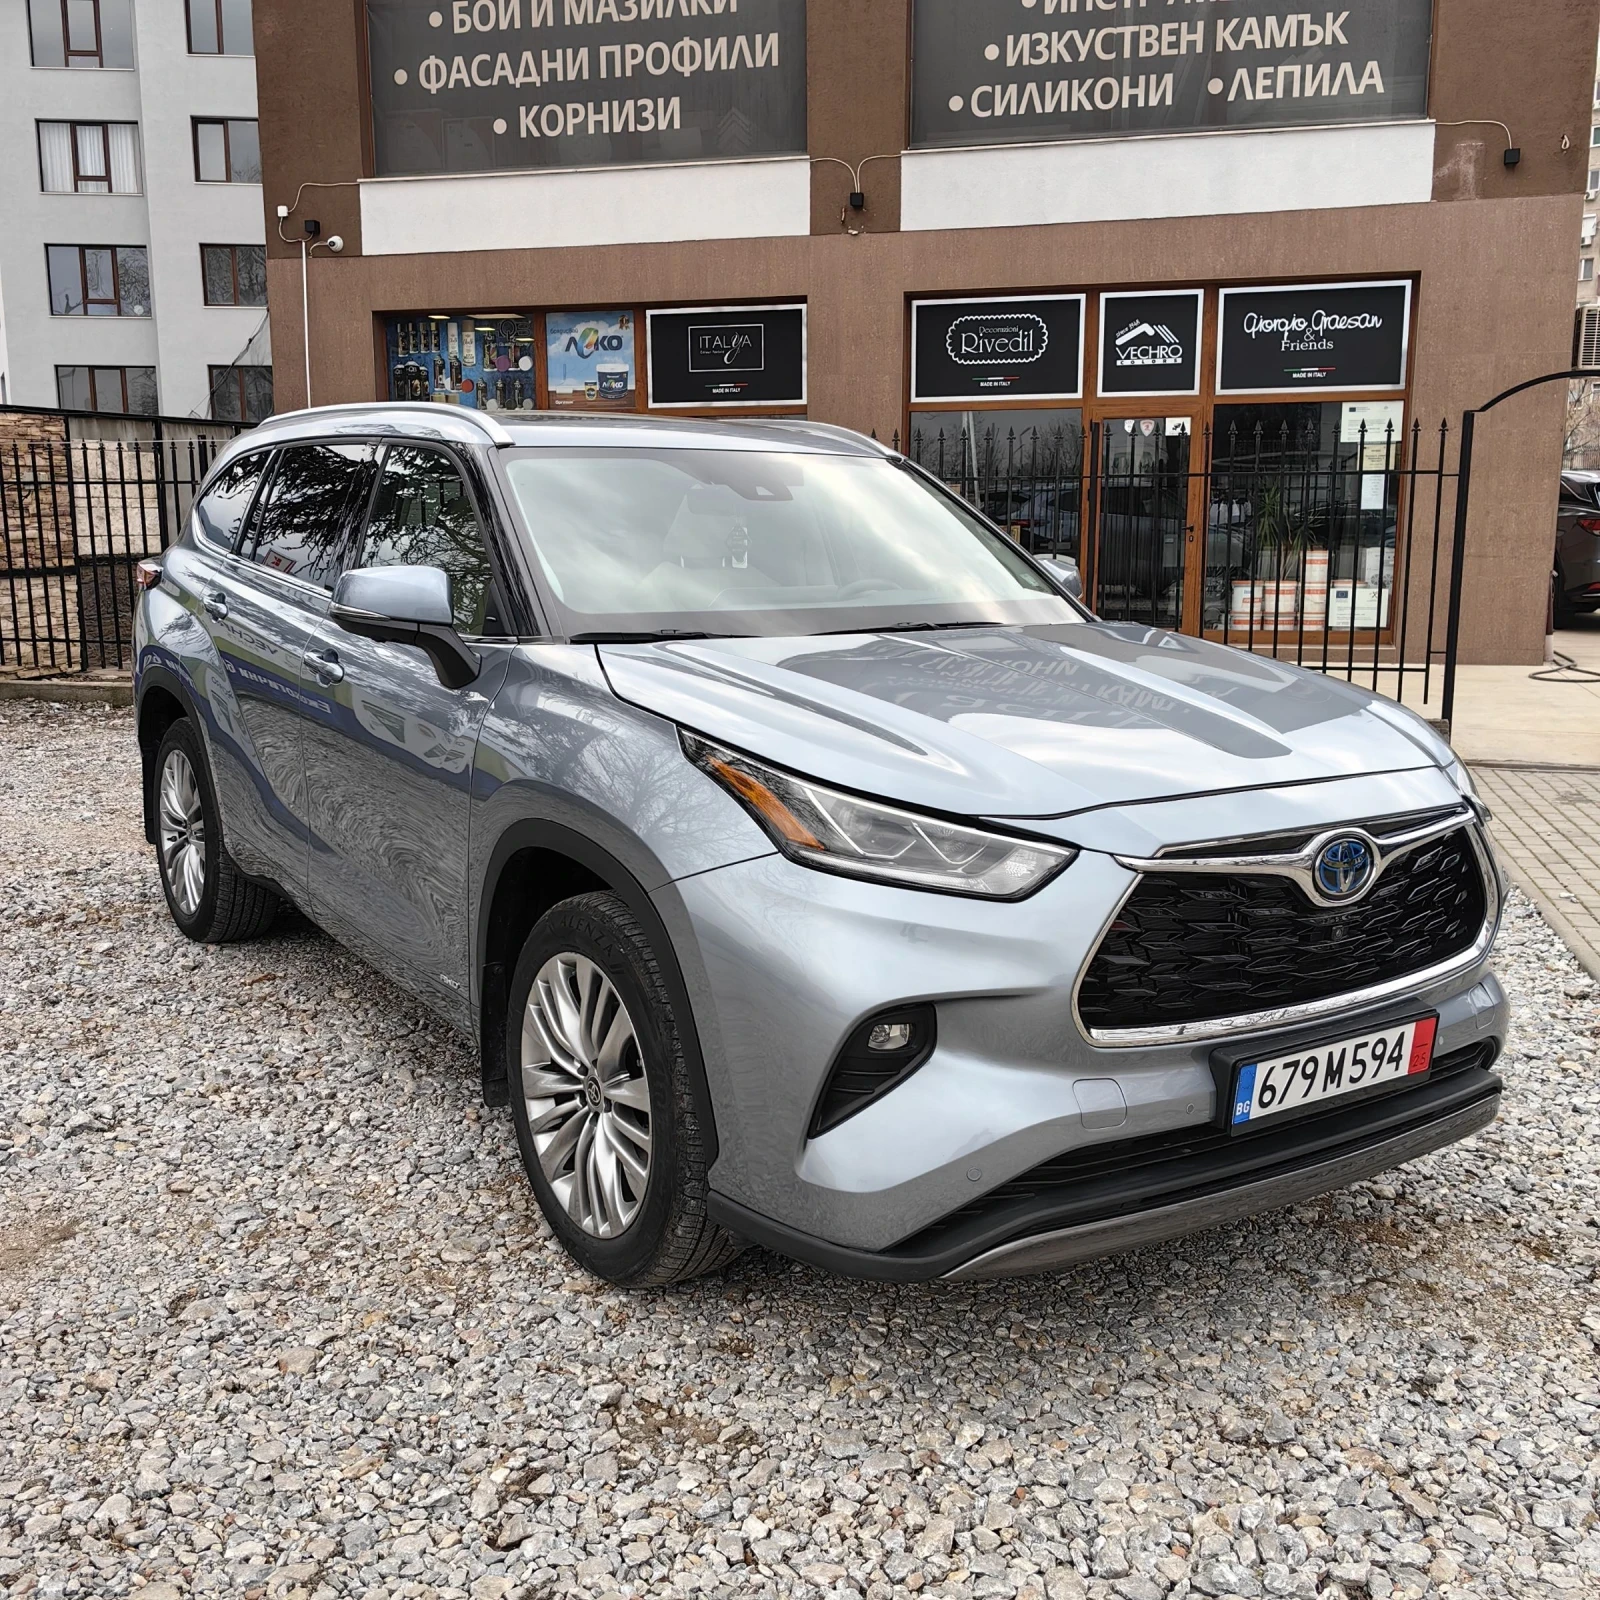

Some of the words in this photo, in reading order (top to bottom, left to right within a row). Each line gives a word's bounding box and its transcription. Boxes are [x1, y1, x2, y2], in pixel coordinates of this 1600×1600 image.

[532, 0, 554, 28] И
[1005, 21, 1204, 67] ИЗКУСТВЕН
[1215, 11, 1350, 53] КАМЪК
[418, 46, 589, 95] ФАСАДНИ
[600, 33, 780, 79] ПРОФИЛИ
[970, 73, 1173, 118] СИЛИКОНИ
[1227, 60, 1385, 102] ЛЕПИЛА
[518, 97, 681, 139] КОРНИЗИ
[978, 325, 1019, 334] Decorazioni
[1243, 312, 1308, 341] Giorgio
[1311, 309, 1382, 336] Graesan
[1303, 327, 1315, 341] &
[960, 328, 1034, 354] Rivedil
[1115, 344, 1183, 360] VECHRO
[1280, 339, 1334, 352] Friends
[560, 914, 613, 957] ALENZA
[1258, 1031, 1405, 1109] 679M594
[1412, 1052, 1427, 1068] 25
[1236, 1102, 1251, 1116] BG
